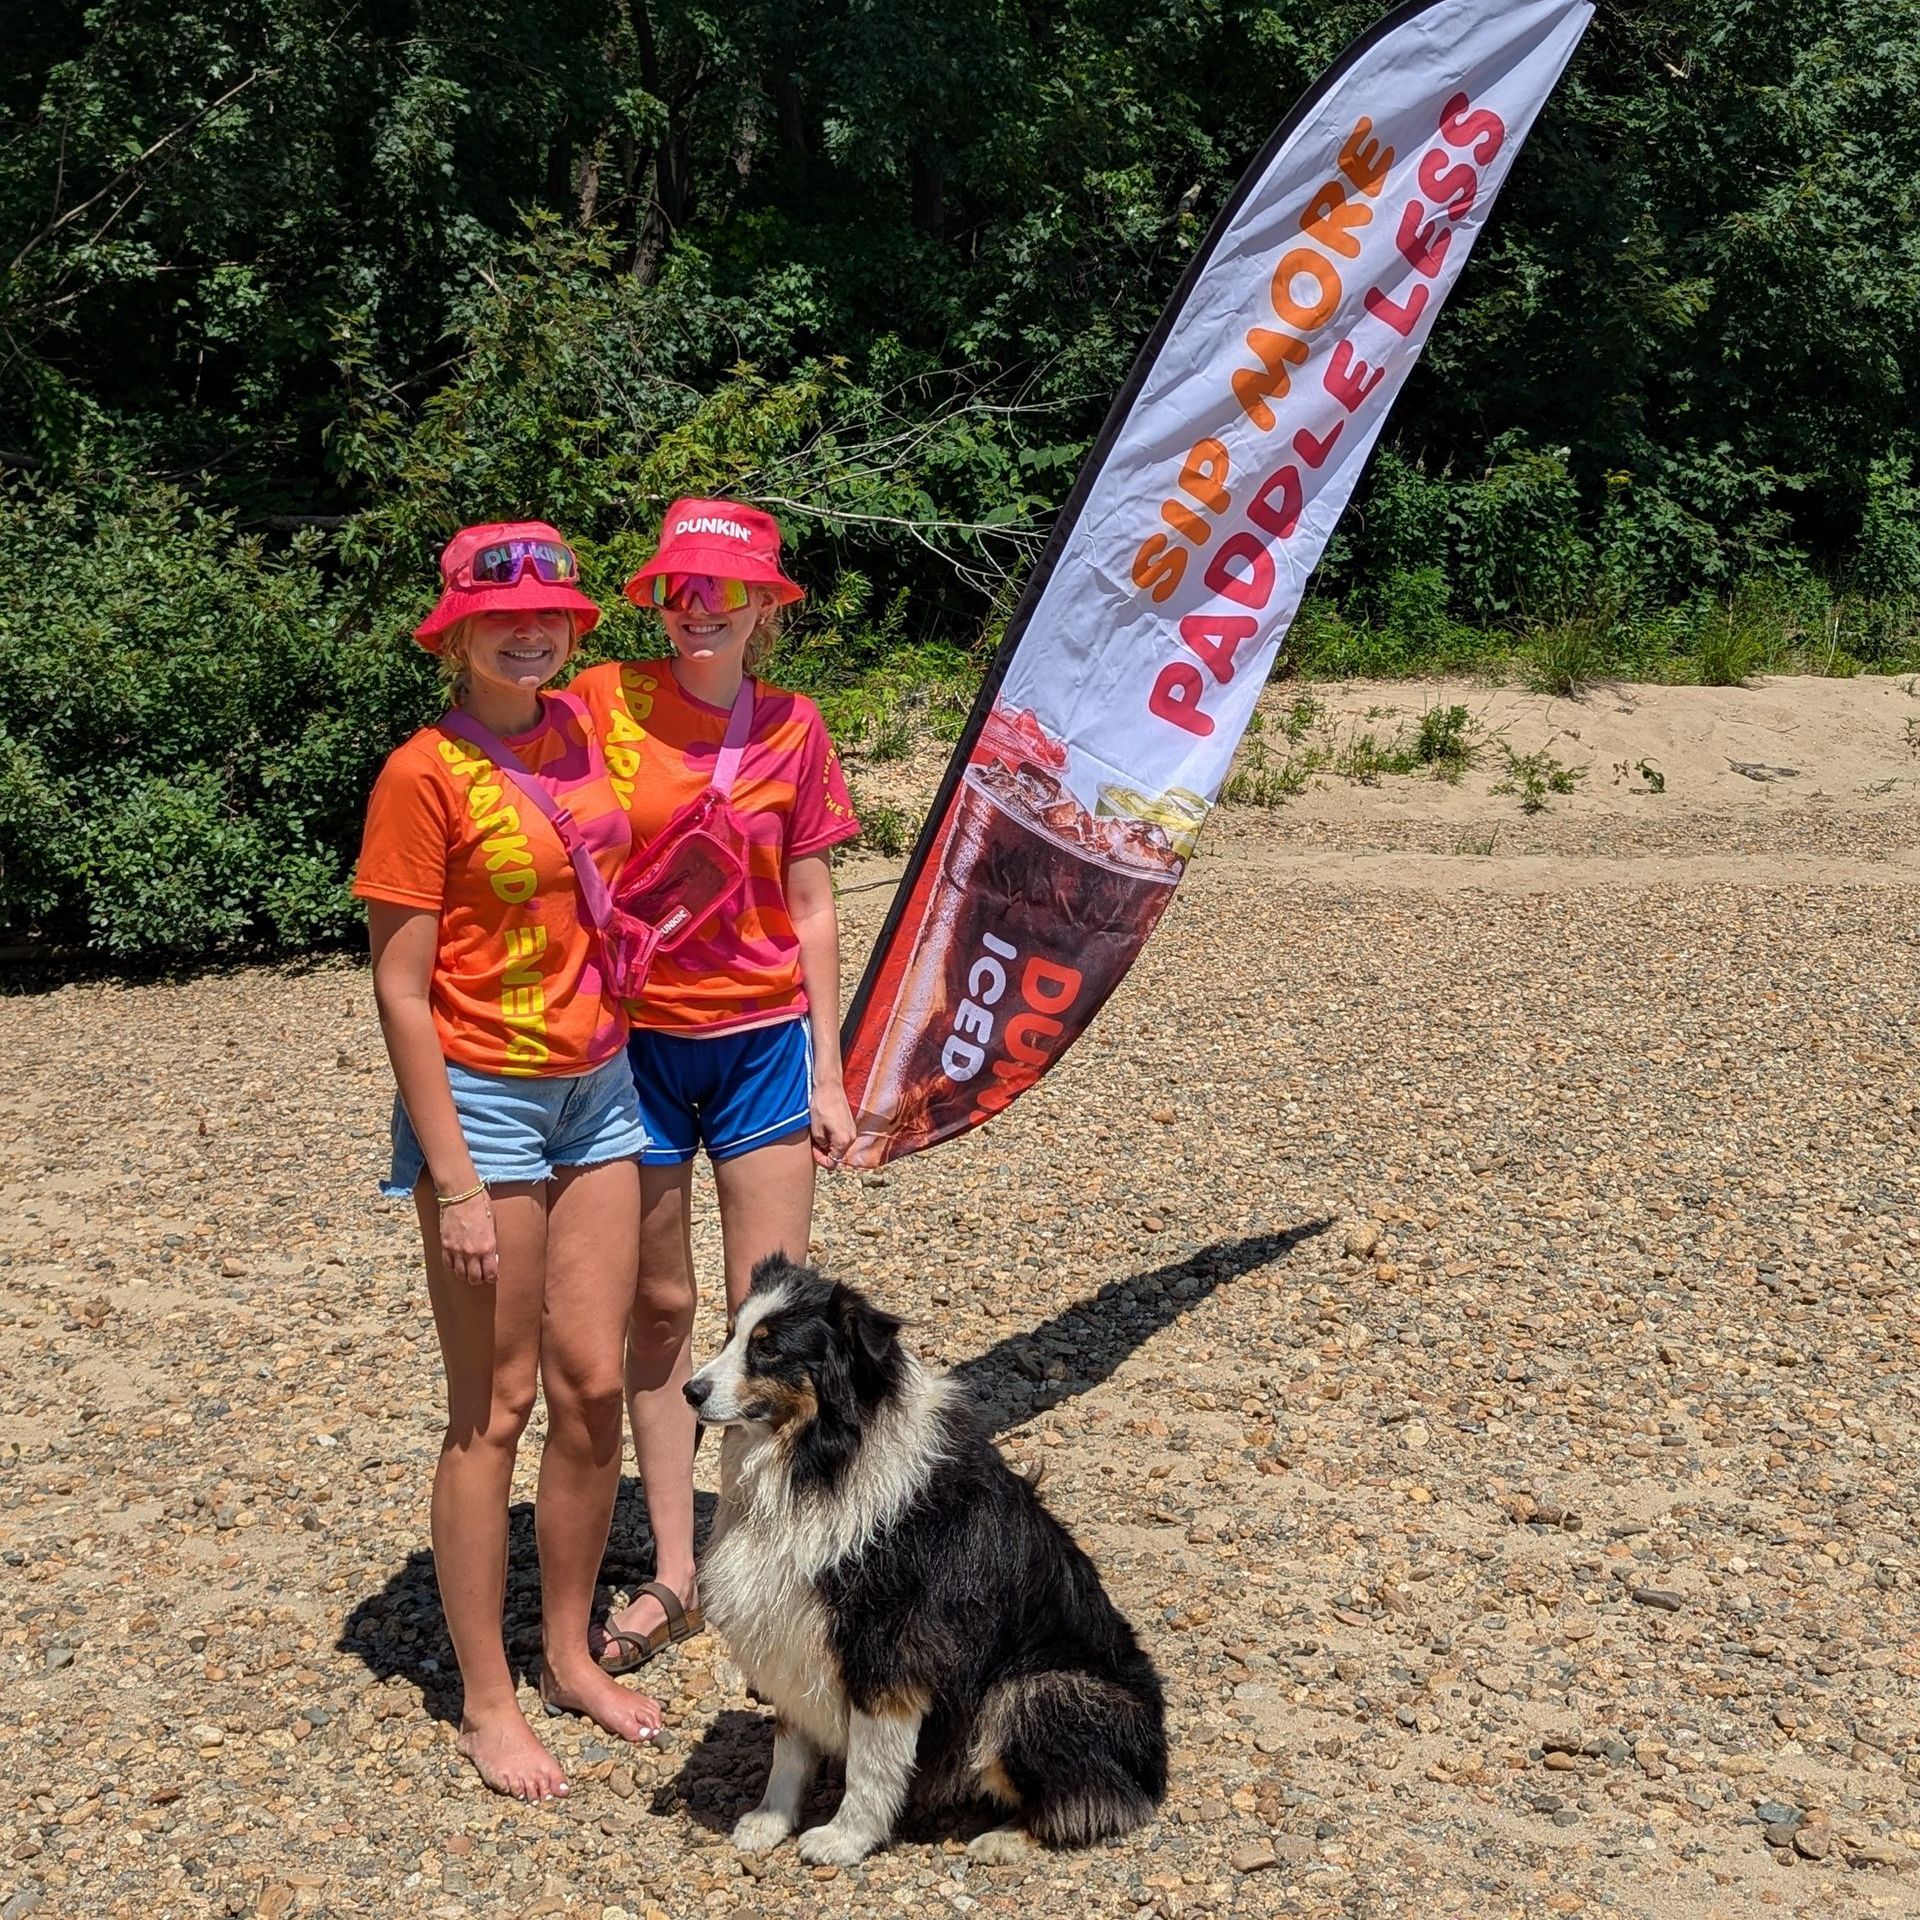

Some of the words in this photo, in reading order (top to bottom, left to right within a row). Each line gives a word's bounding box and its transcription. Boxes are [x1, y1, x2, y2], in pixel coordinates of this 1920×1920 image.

[1132, 437, 1232, 603] SIP
[1231, 116, 1396, 432] MORE
[1149, 339, 1385, 737] PADDLE
[1365, 92, 1505, 336] LESS
[660, 908, 688, 938] UNKIN'
[941, 932, 1017, 1082] ICED
[969, 956, 1082, 1124] DUN
